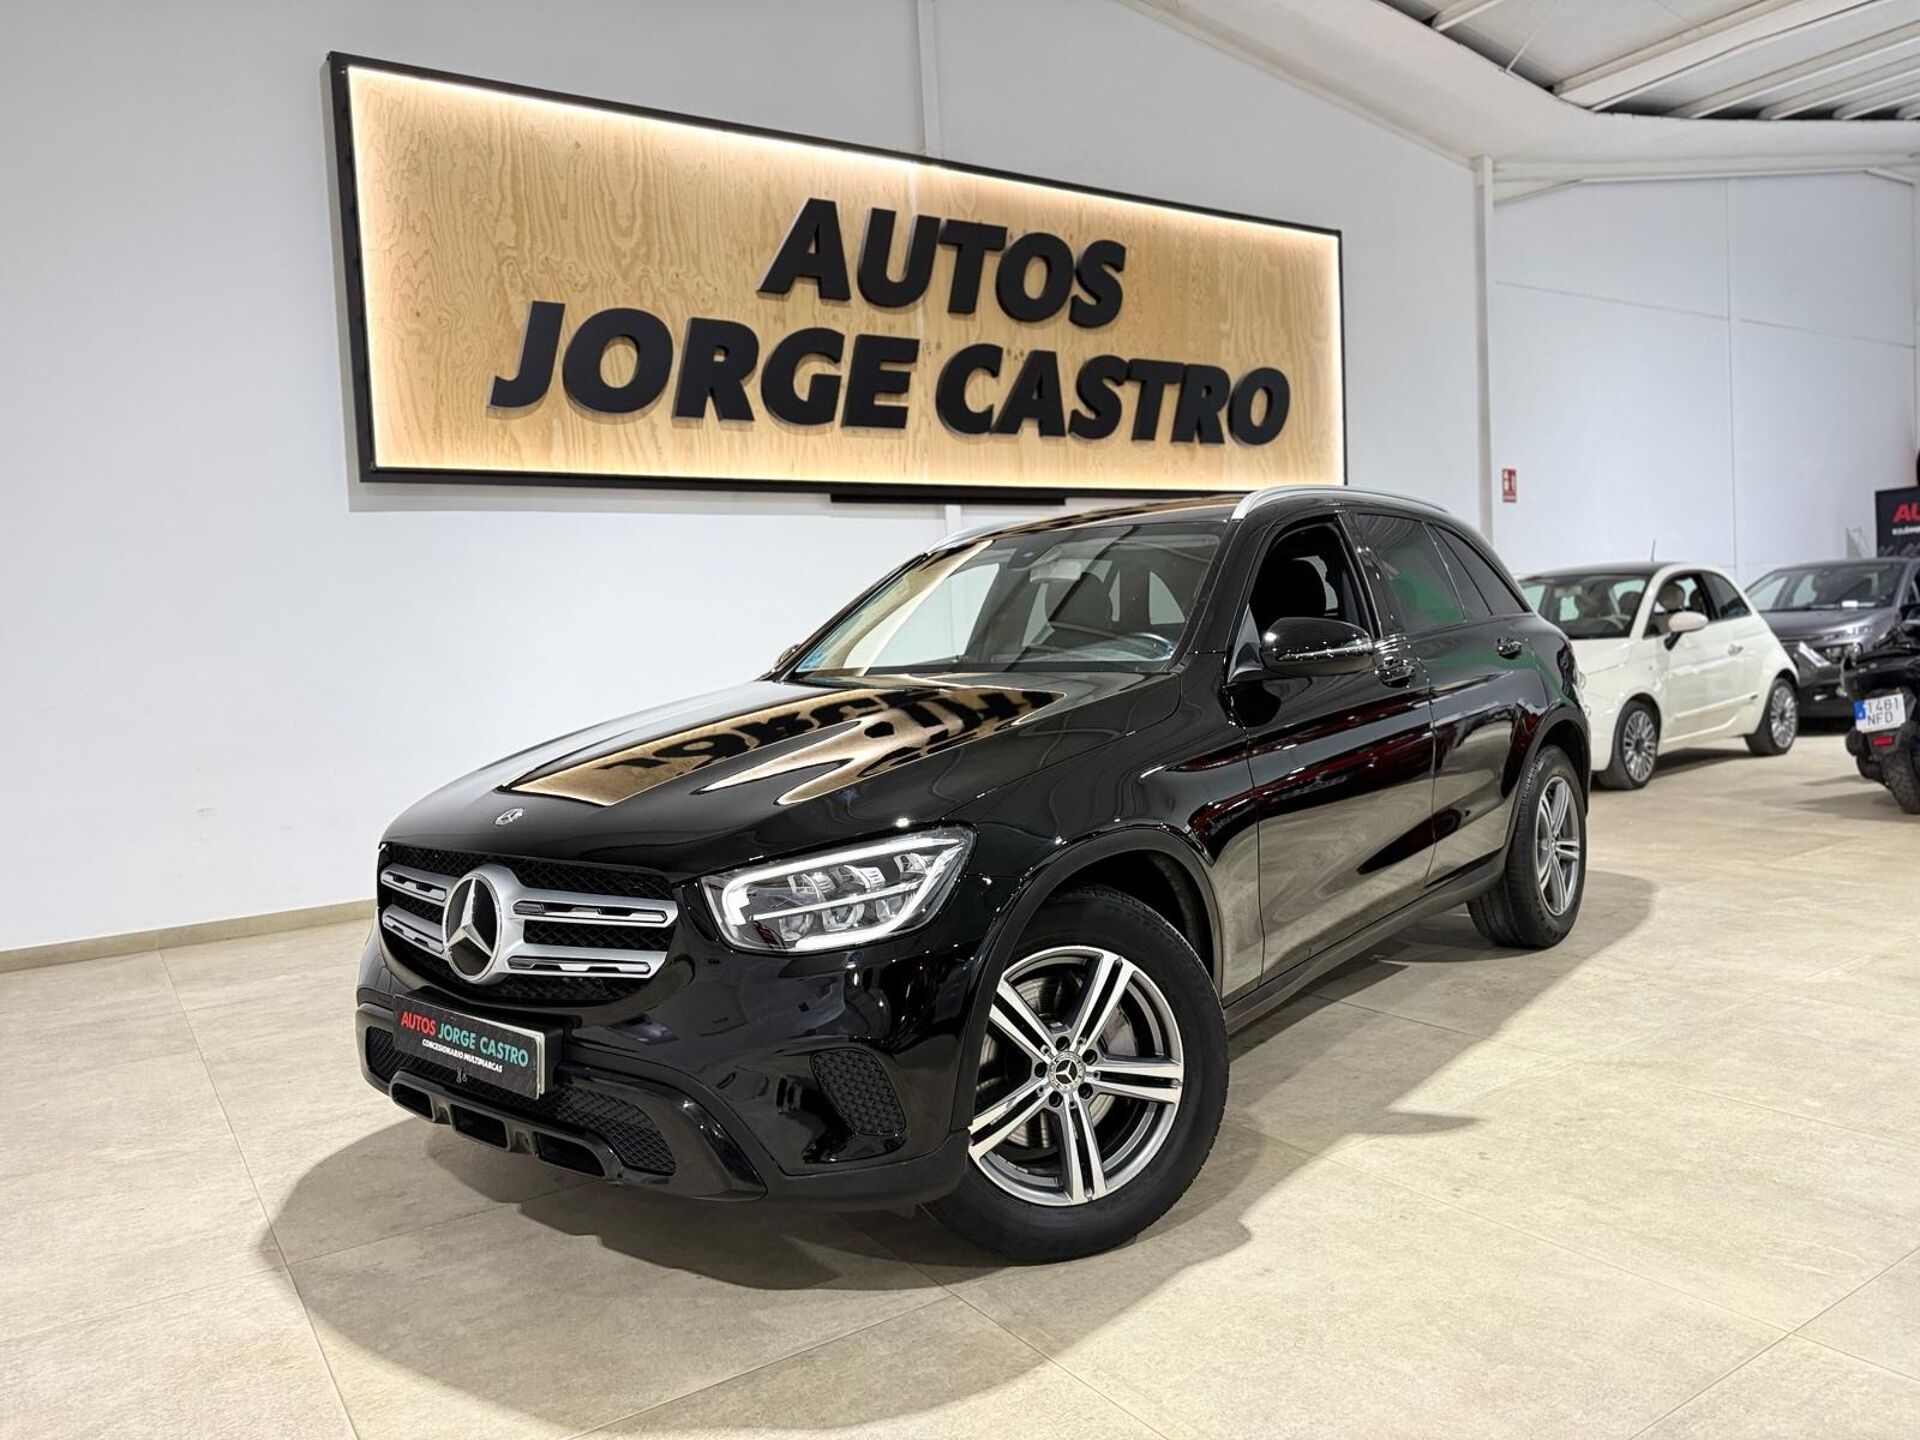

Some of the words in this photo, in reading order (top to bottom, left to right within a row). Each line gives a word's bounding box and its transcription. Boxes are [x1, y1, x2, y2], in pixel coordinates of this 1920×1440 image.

[757, 197, 1126, 329] AUTOS
[489, 300, 922, 429] JORGE
[935, 343, 1291, 446] CASTRO
[401, 1011, 437, 1036] AUTOS
[438, 1023, 475, 1050] JORGE
[480, 1036, 529, 1067] CASTRO
